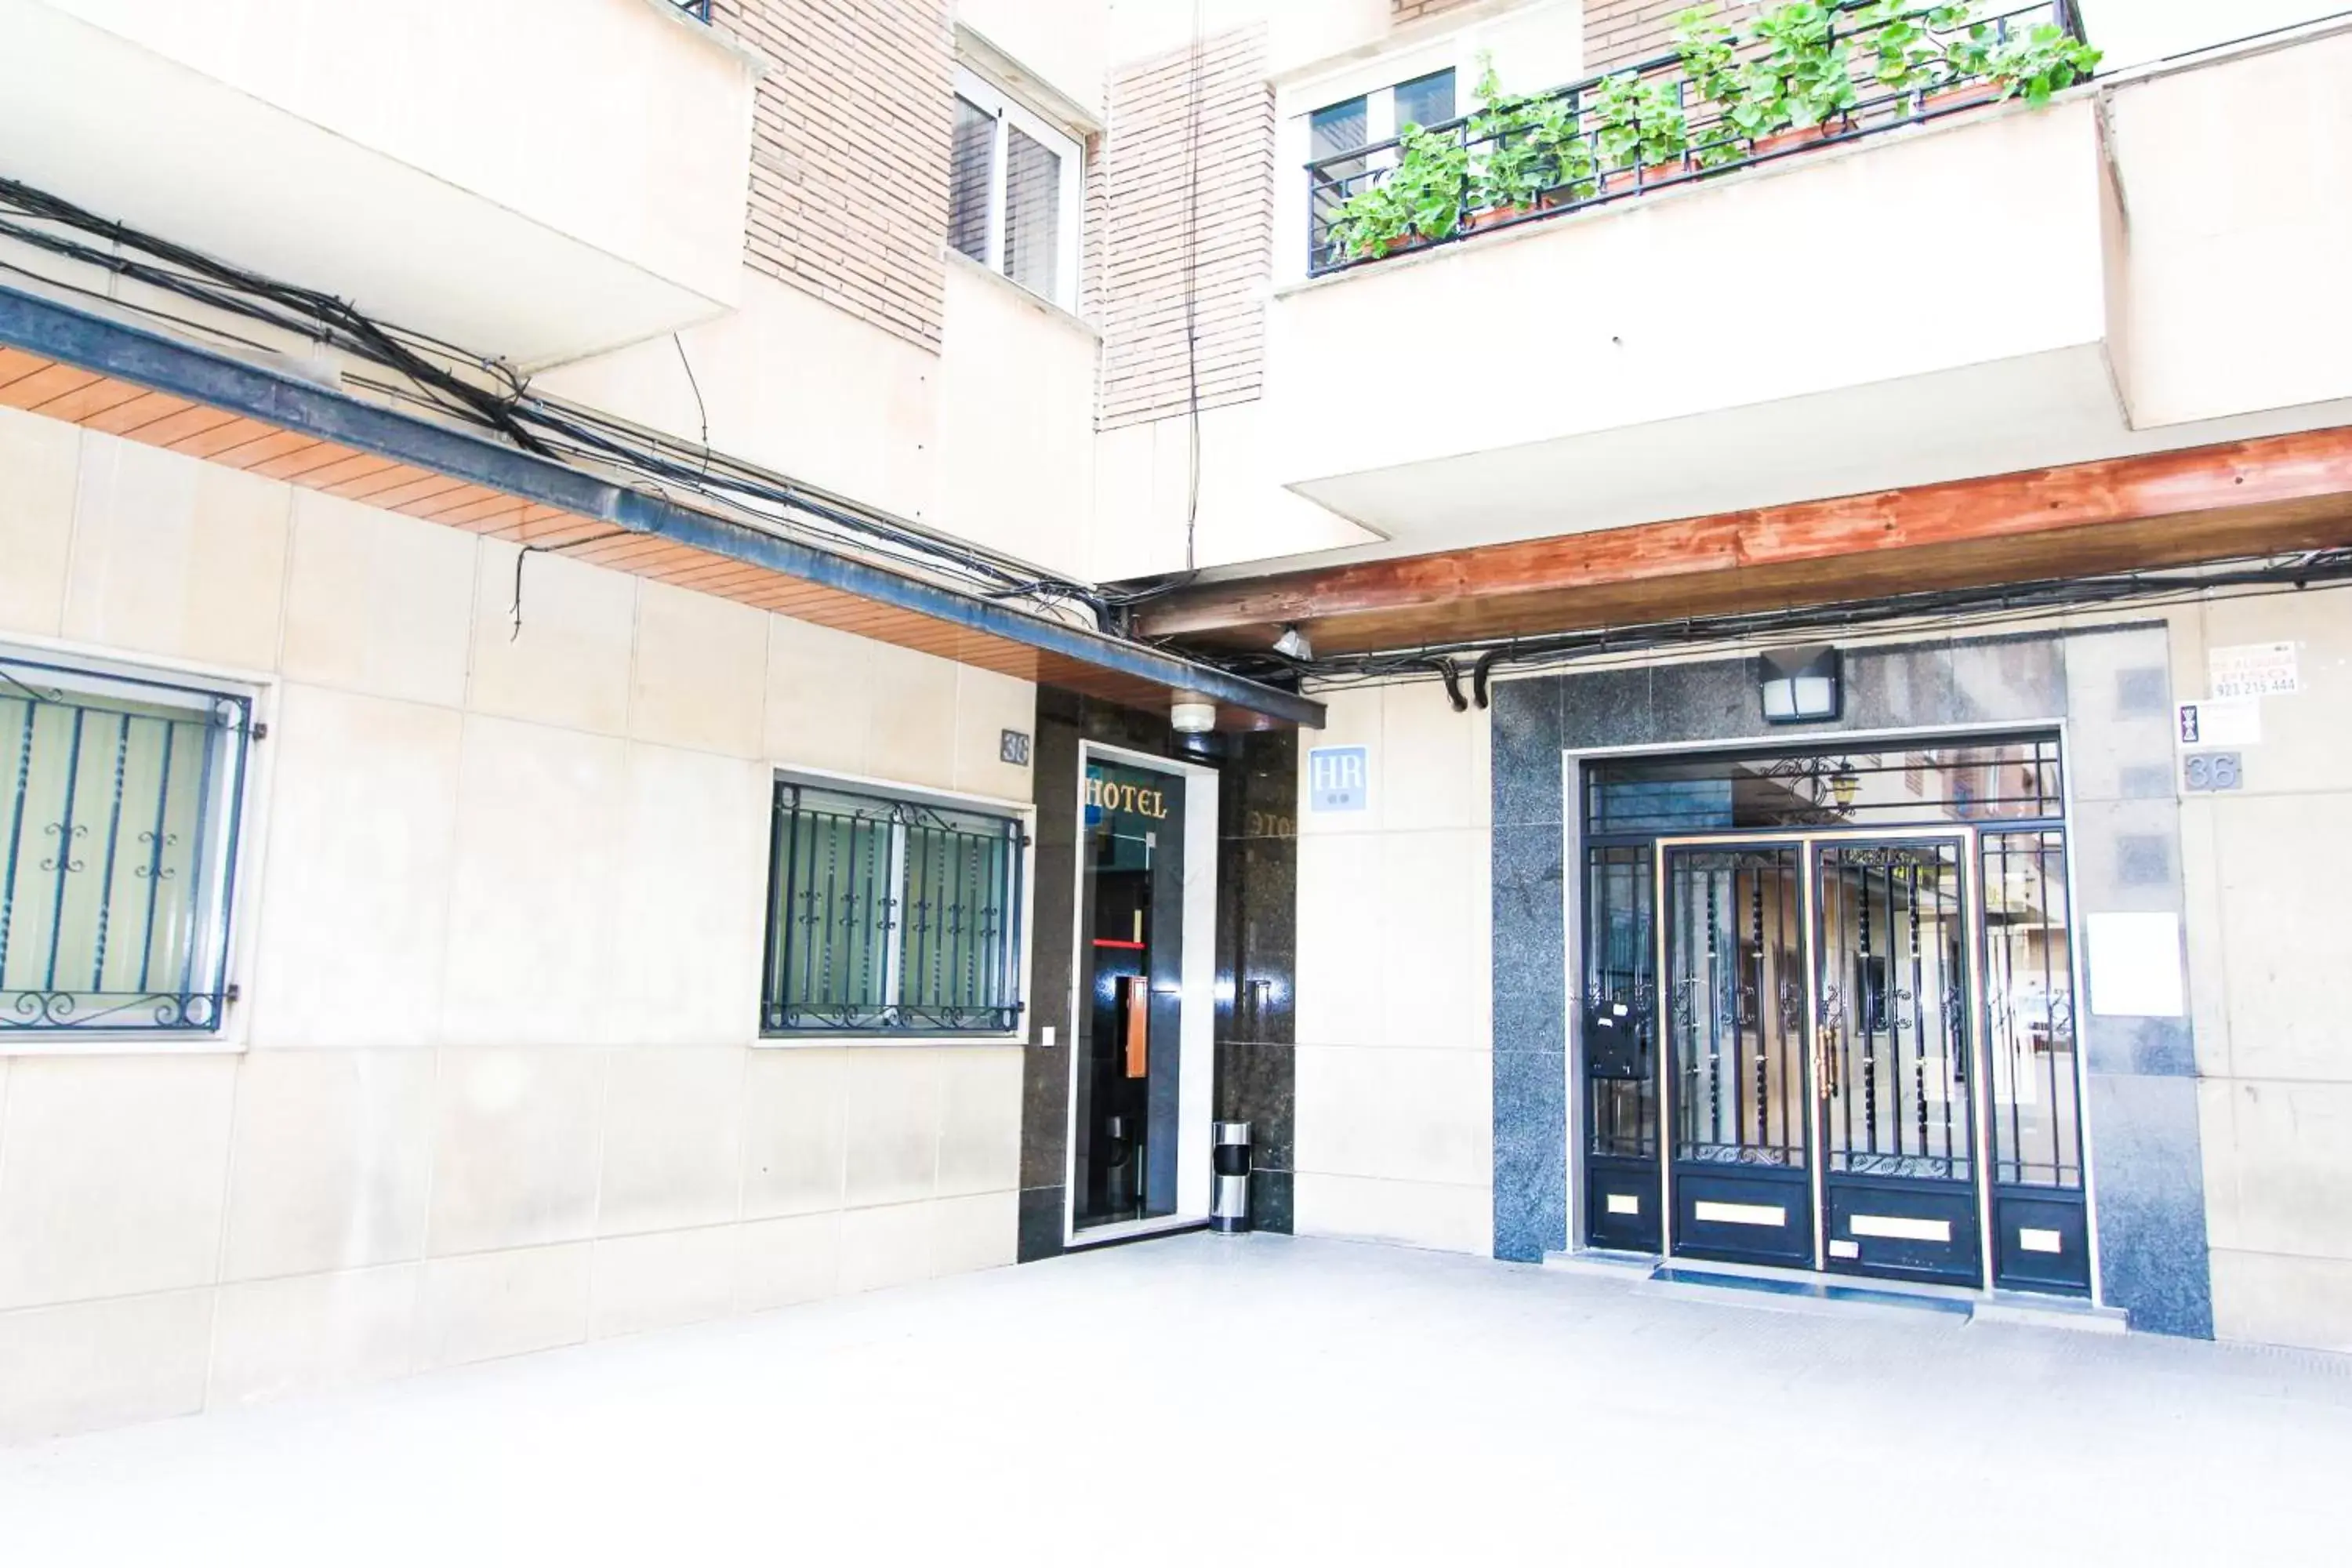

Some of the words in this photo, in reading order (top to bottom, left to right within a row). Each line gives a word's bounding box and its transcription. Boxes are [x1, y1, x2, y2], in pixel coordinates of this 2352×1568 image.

[1003, 733, 1028, 764] 36
[1315, 755, 1363, 792] HR
[2187, 755, 2235, 787] 36
[1084, 777, 1167, 818] HOTEL
